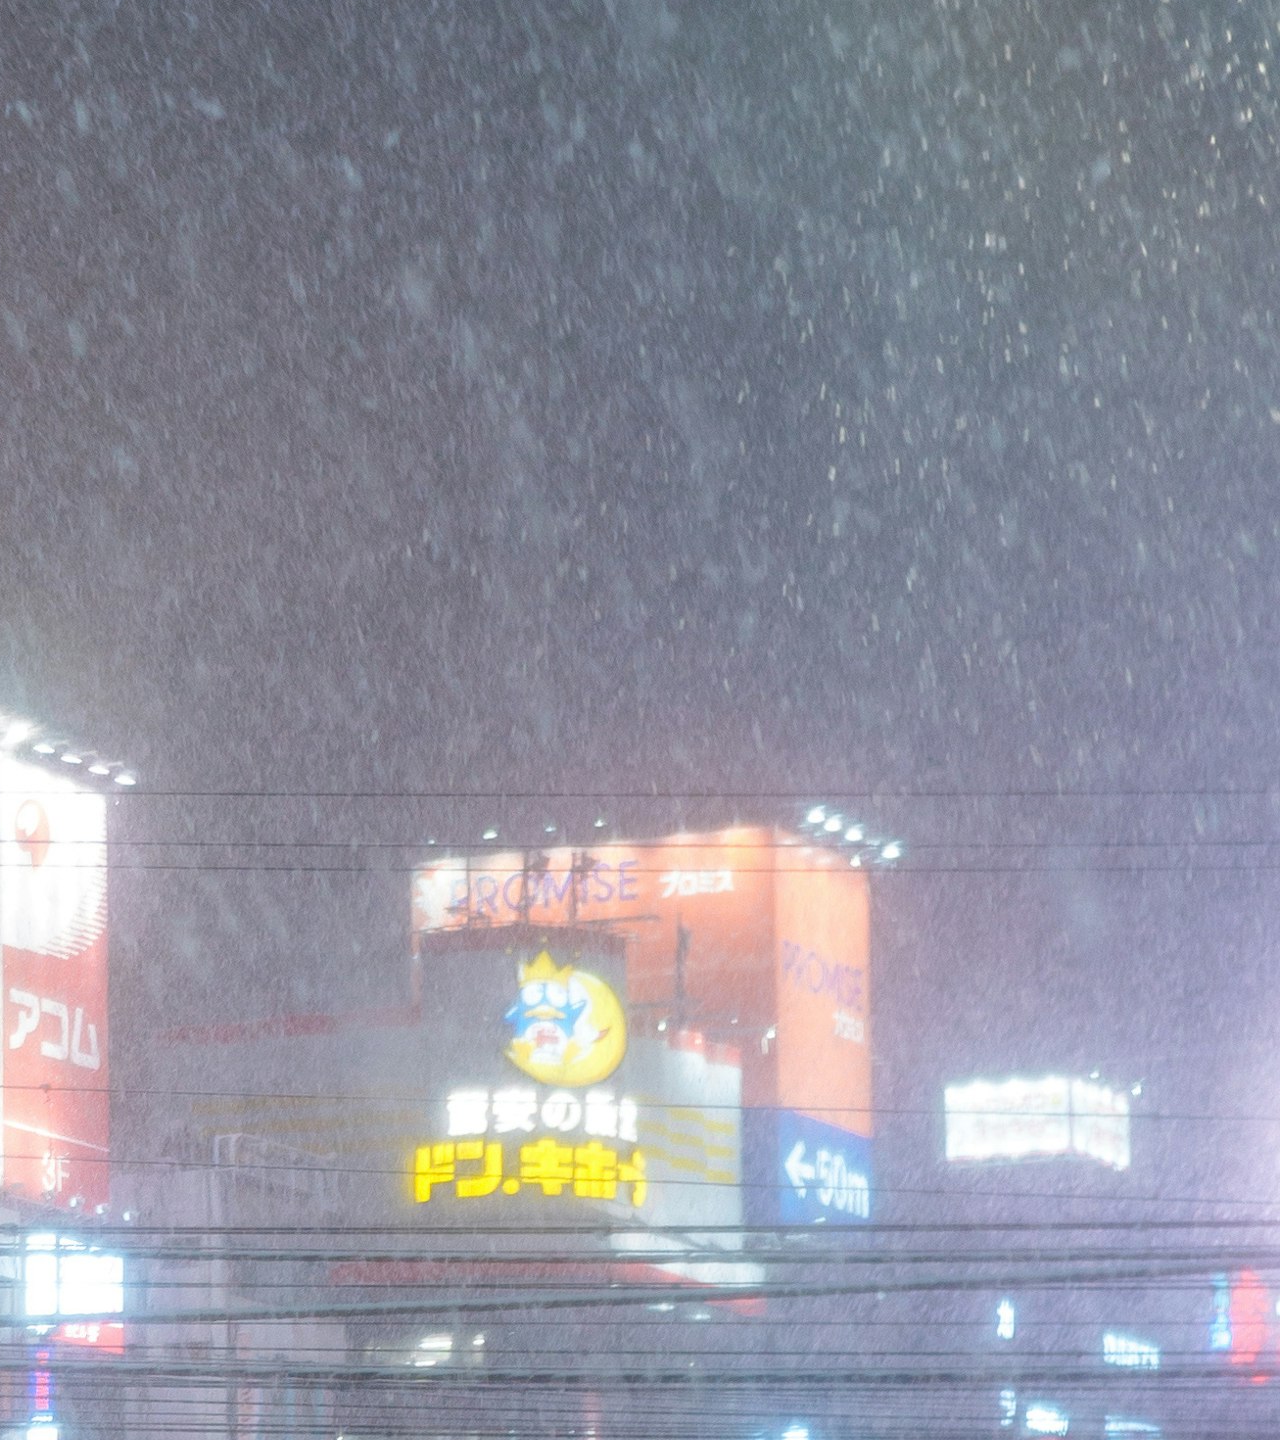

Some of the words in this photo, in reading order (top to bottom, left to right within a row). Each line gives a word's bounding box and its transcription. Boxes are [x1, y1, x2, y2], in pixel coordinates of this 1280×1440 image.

[448, 861, 639, 916] PROMISE
[8, 988, 101, 1071] アコム
